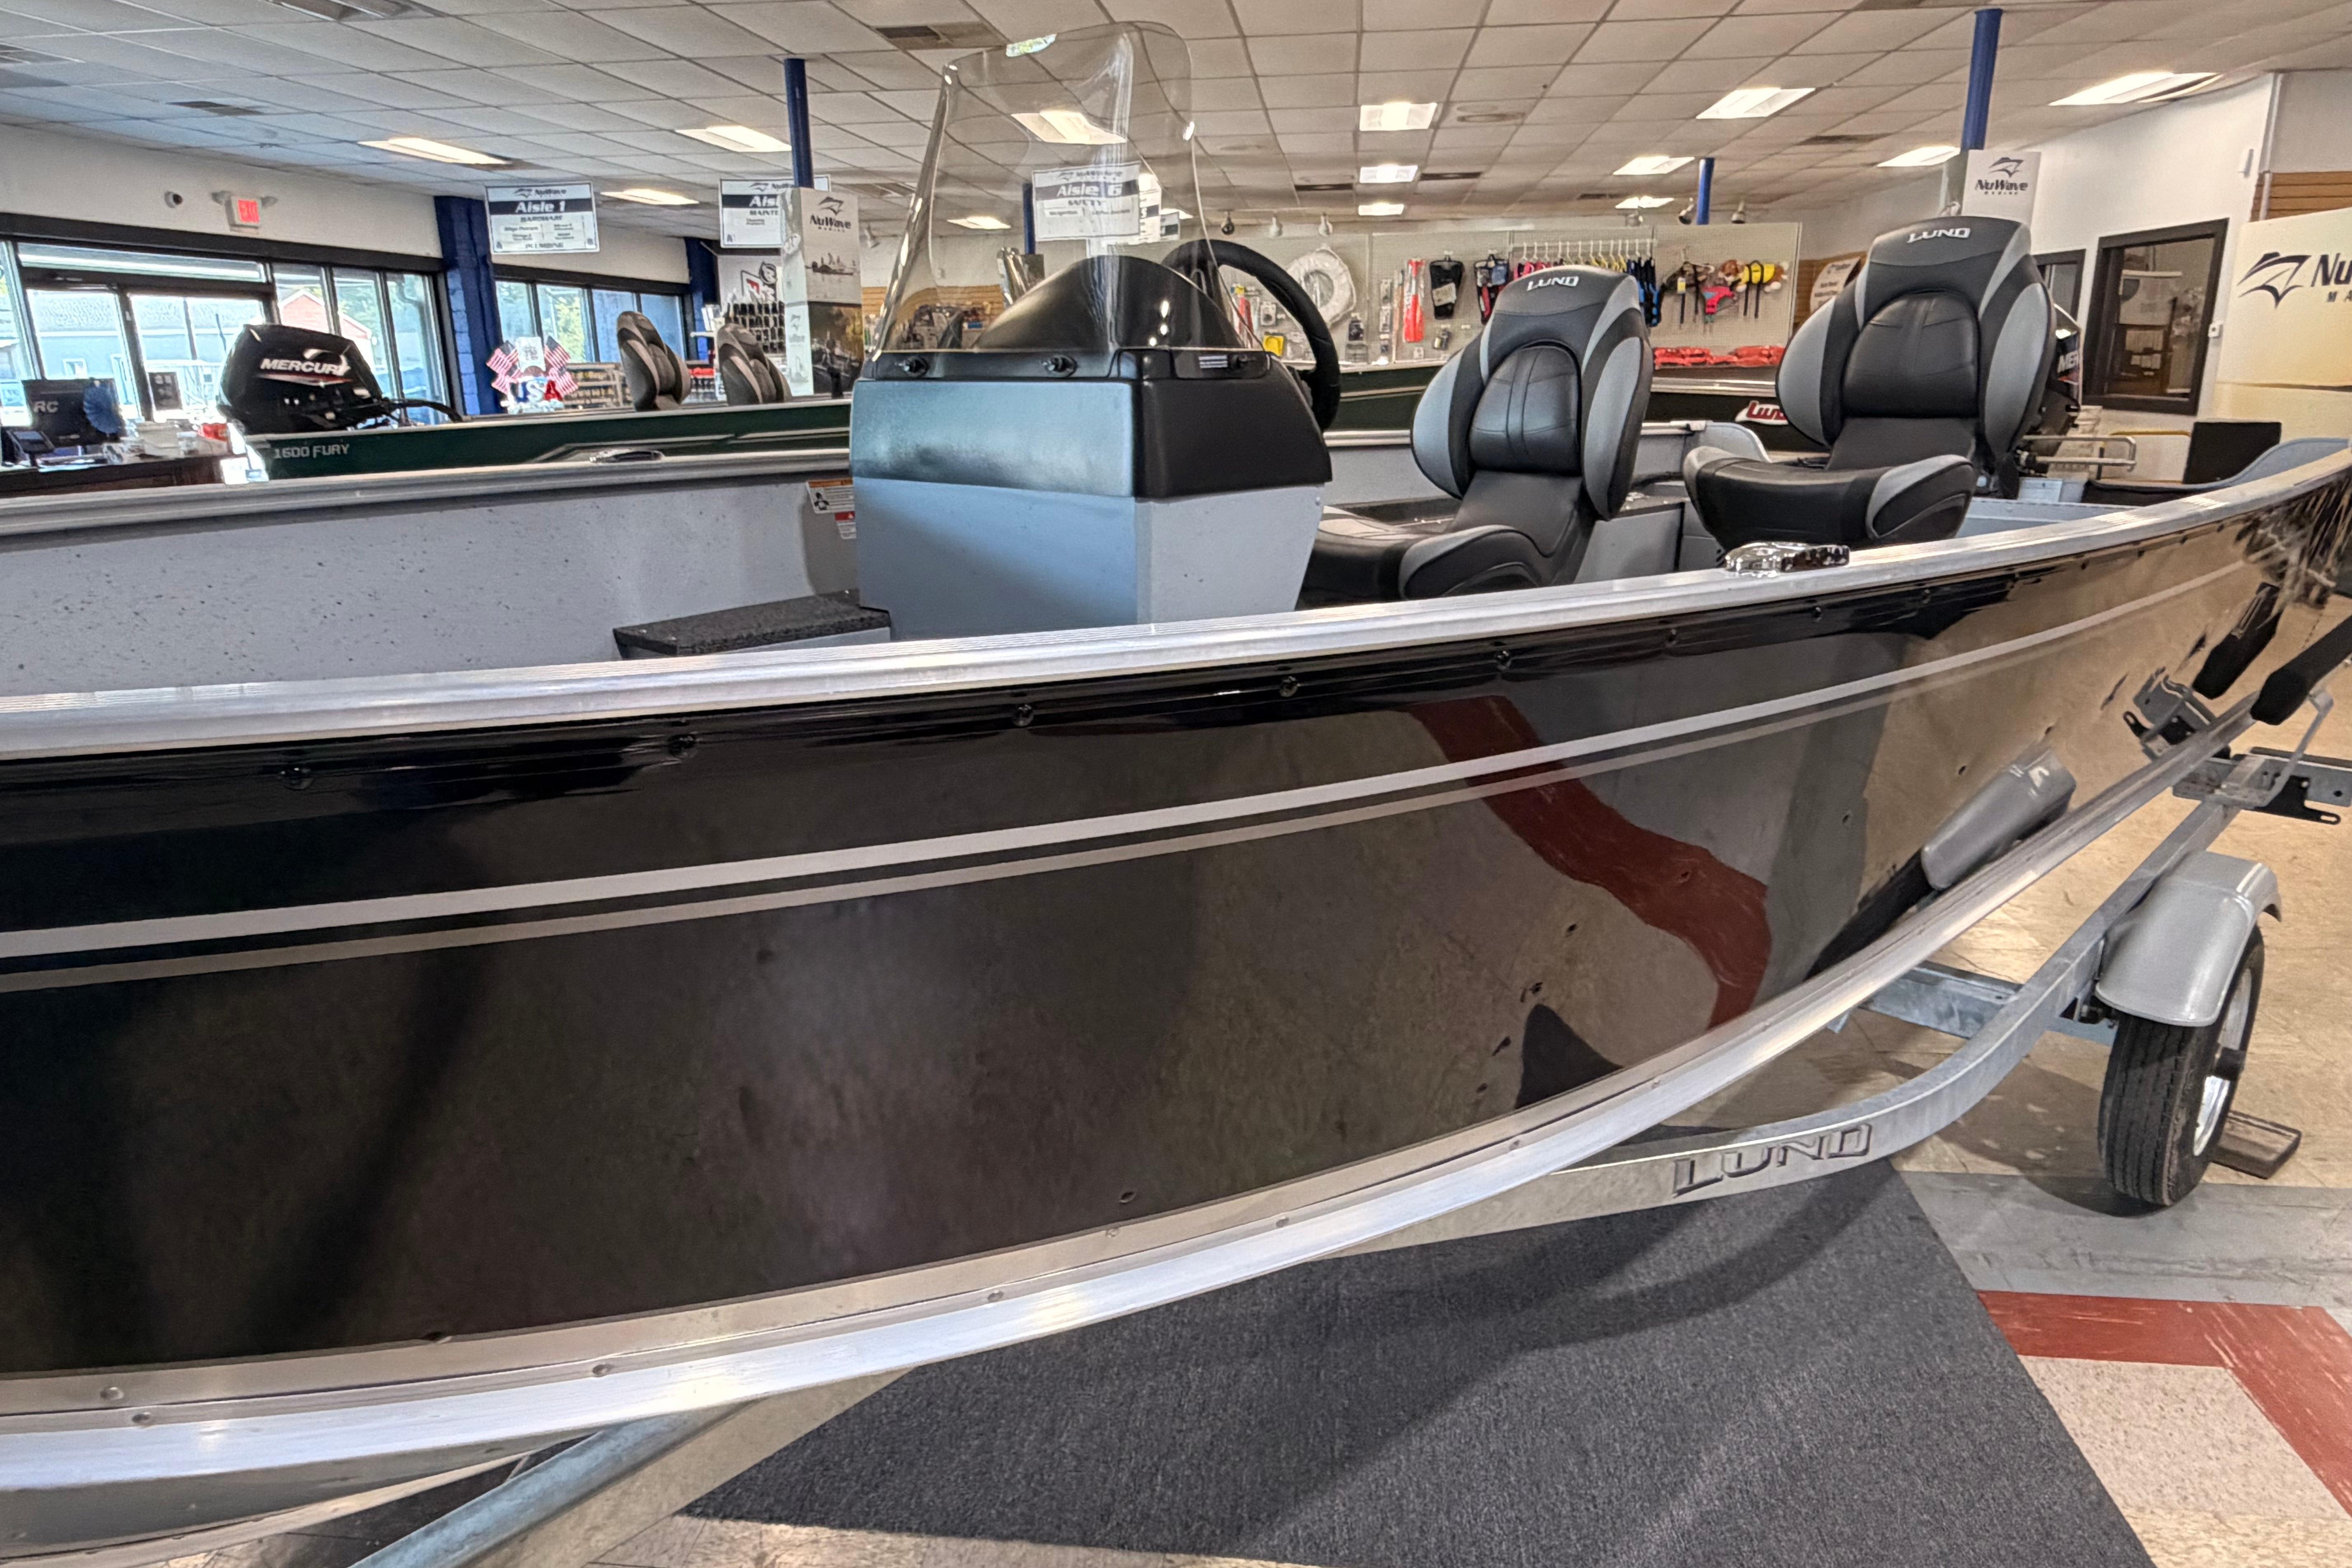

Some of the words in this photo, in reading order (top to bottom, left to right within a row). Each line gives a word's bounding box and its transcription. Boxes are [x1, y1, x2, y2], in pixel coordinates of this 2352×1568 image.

[1057, 183, 1100, 197] Aisle
[1107, 184, 1123, 196] 6
[1975, 180, 2028, 191] NuWave
[515, 201, 555, 213] Aisle
[560, 200, 566, 212] 1
[749, 196, 779, 207] Ais
[810, 215, 851, 229] NuWave
[1906, 228, 1971, 243] LUND
[1526, 276, 1579, 291] LUND
[260, 358, 351, 376] MERCURY
[273, 446, 309, 459] 1600
[312, 443, 349, 459] FURY
[1673, 1122, 1873, 1197] LUND
